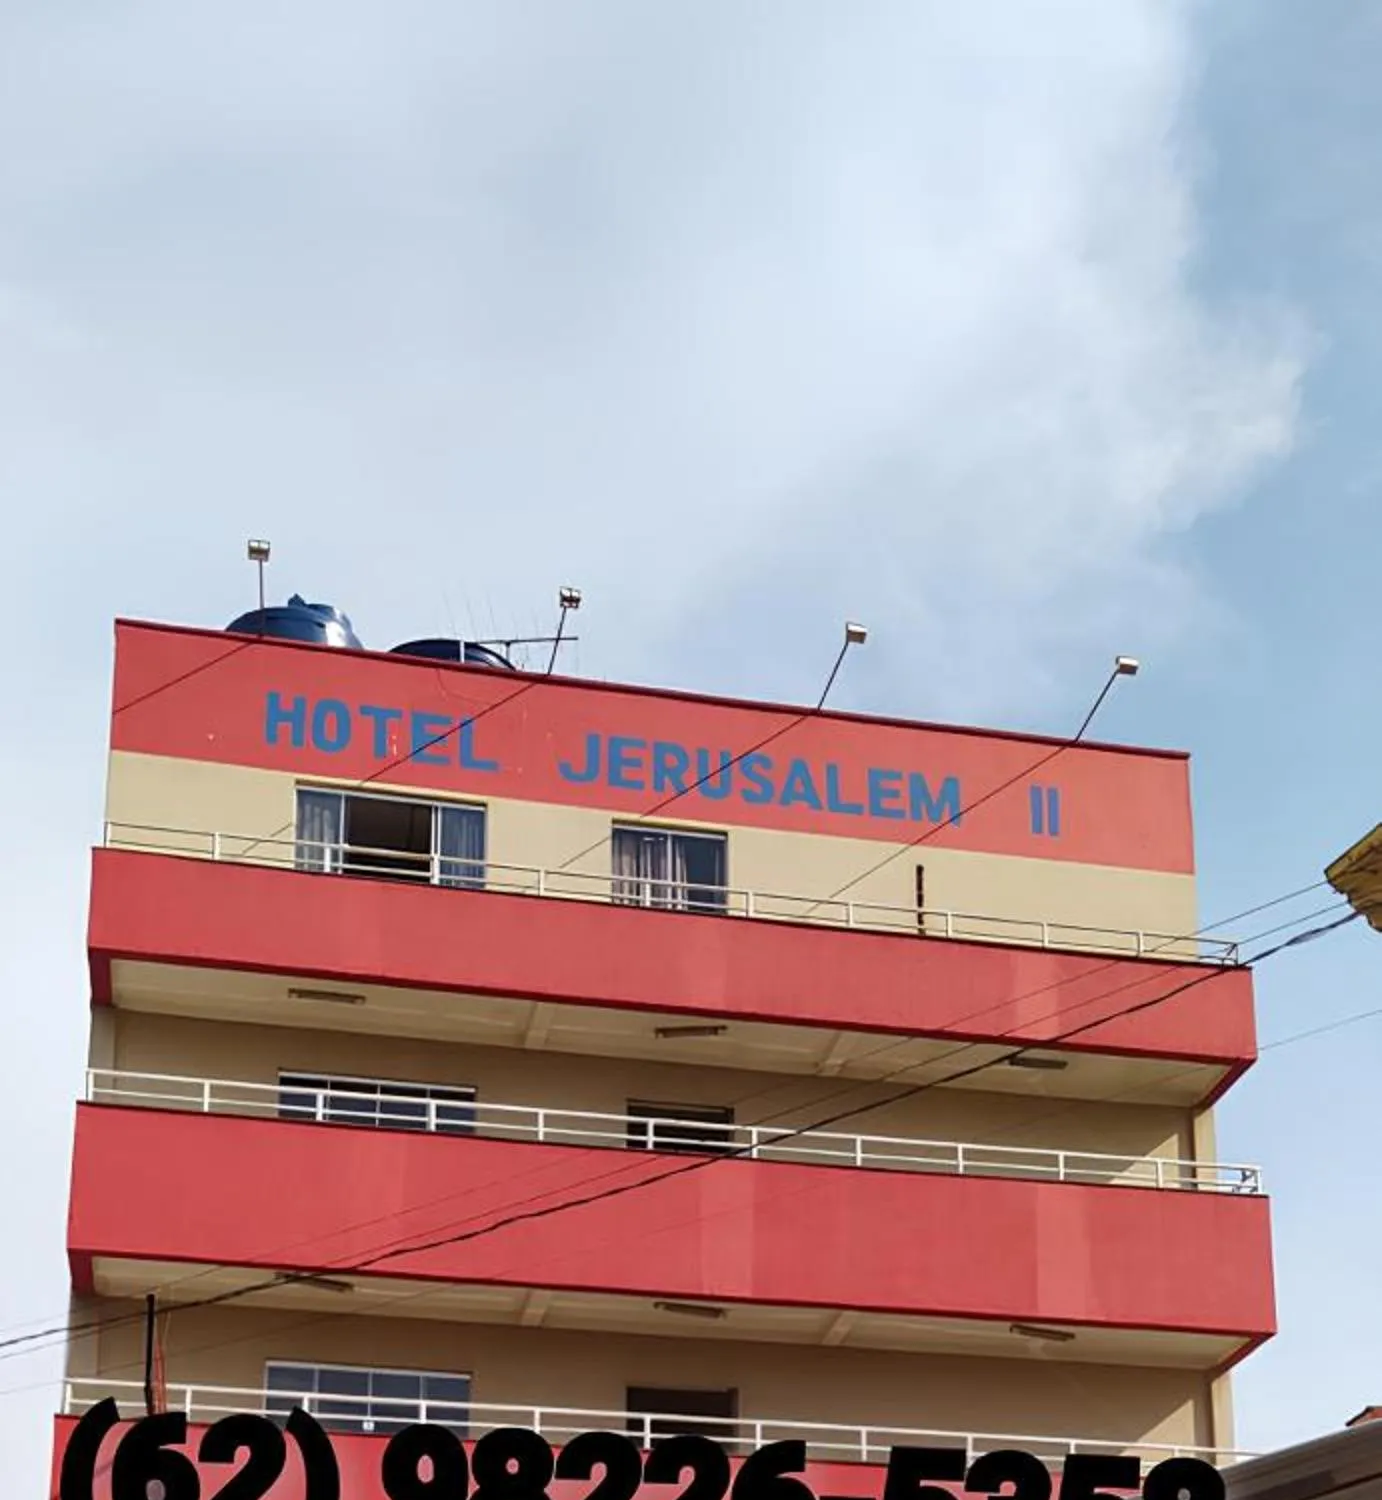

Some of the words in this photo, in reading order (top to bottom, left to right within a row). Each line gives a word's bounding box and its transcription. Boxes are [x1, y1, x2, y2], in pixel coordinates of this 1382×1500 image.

[264, 691, 499, 773] HOTEL
[558, 732, 962, 827] JERUSALEM
[1029, 784, 1060, 837] II
